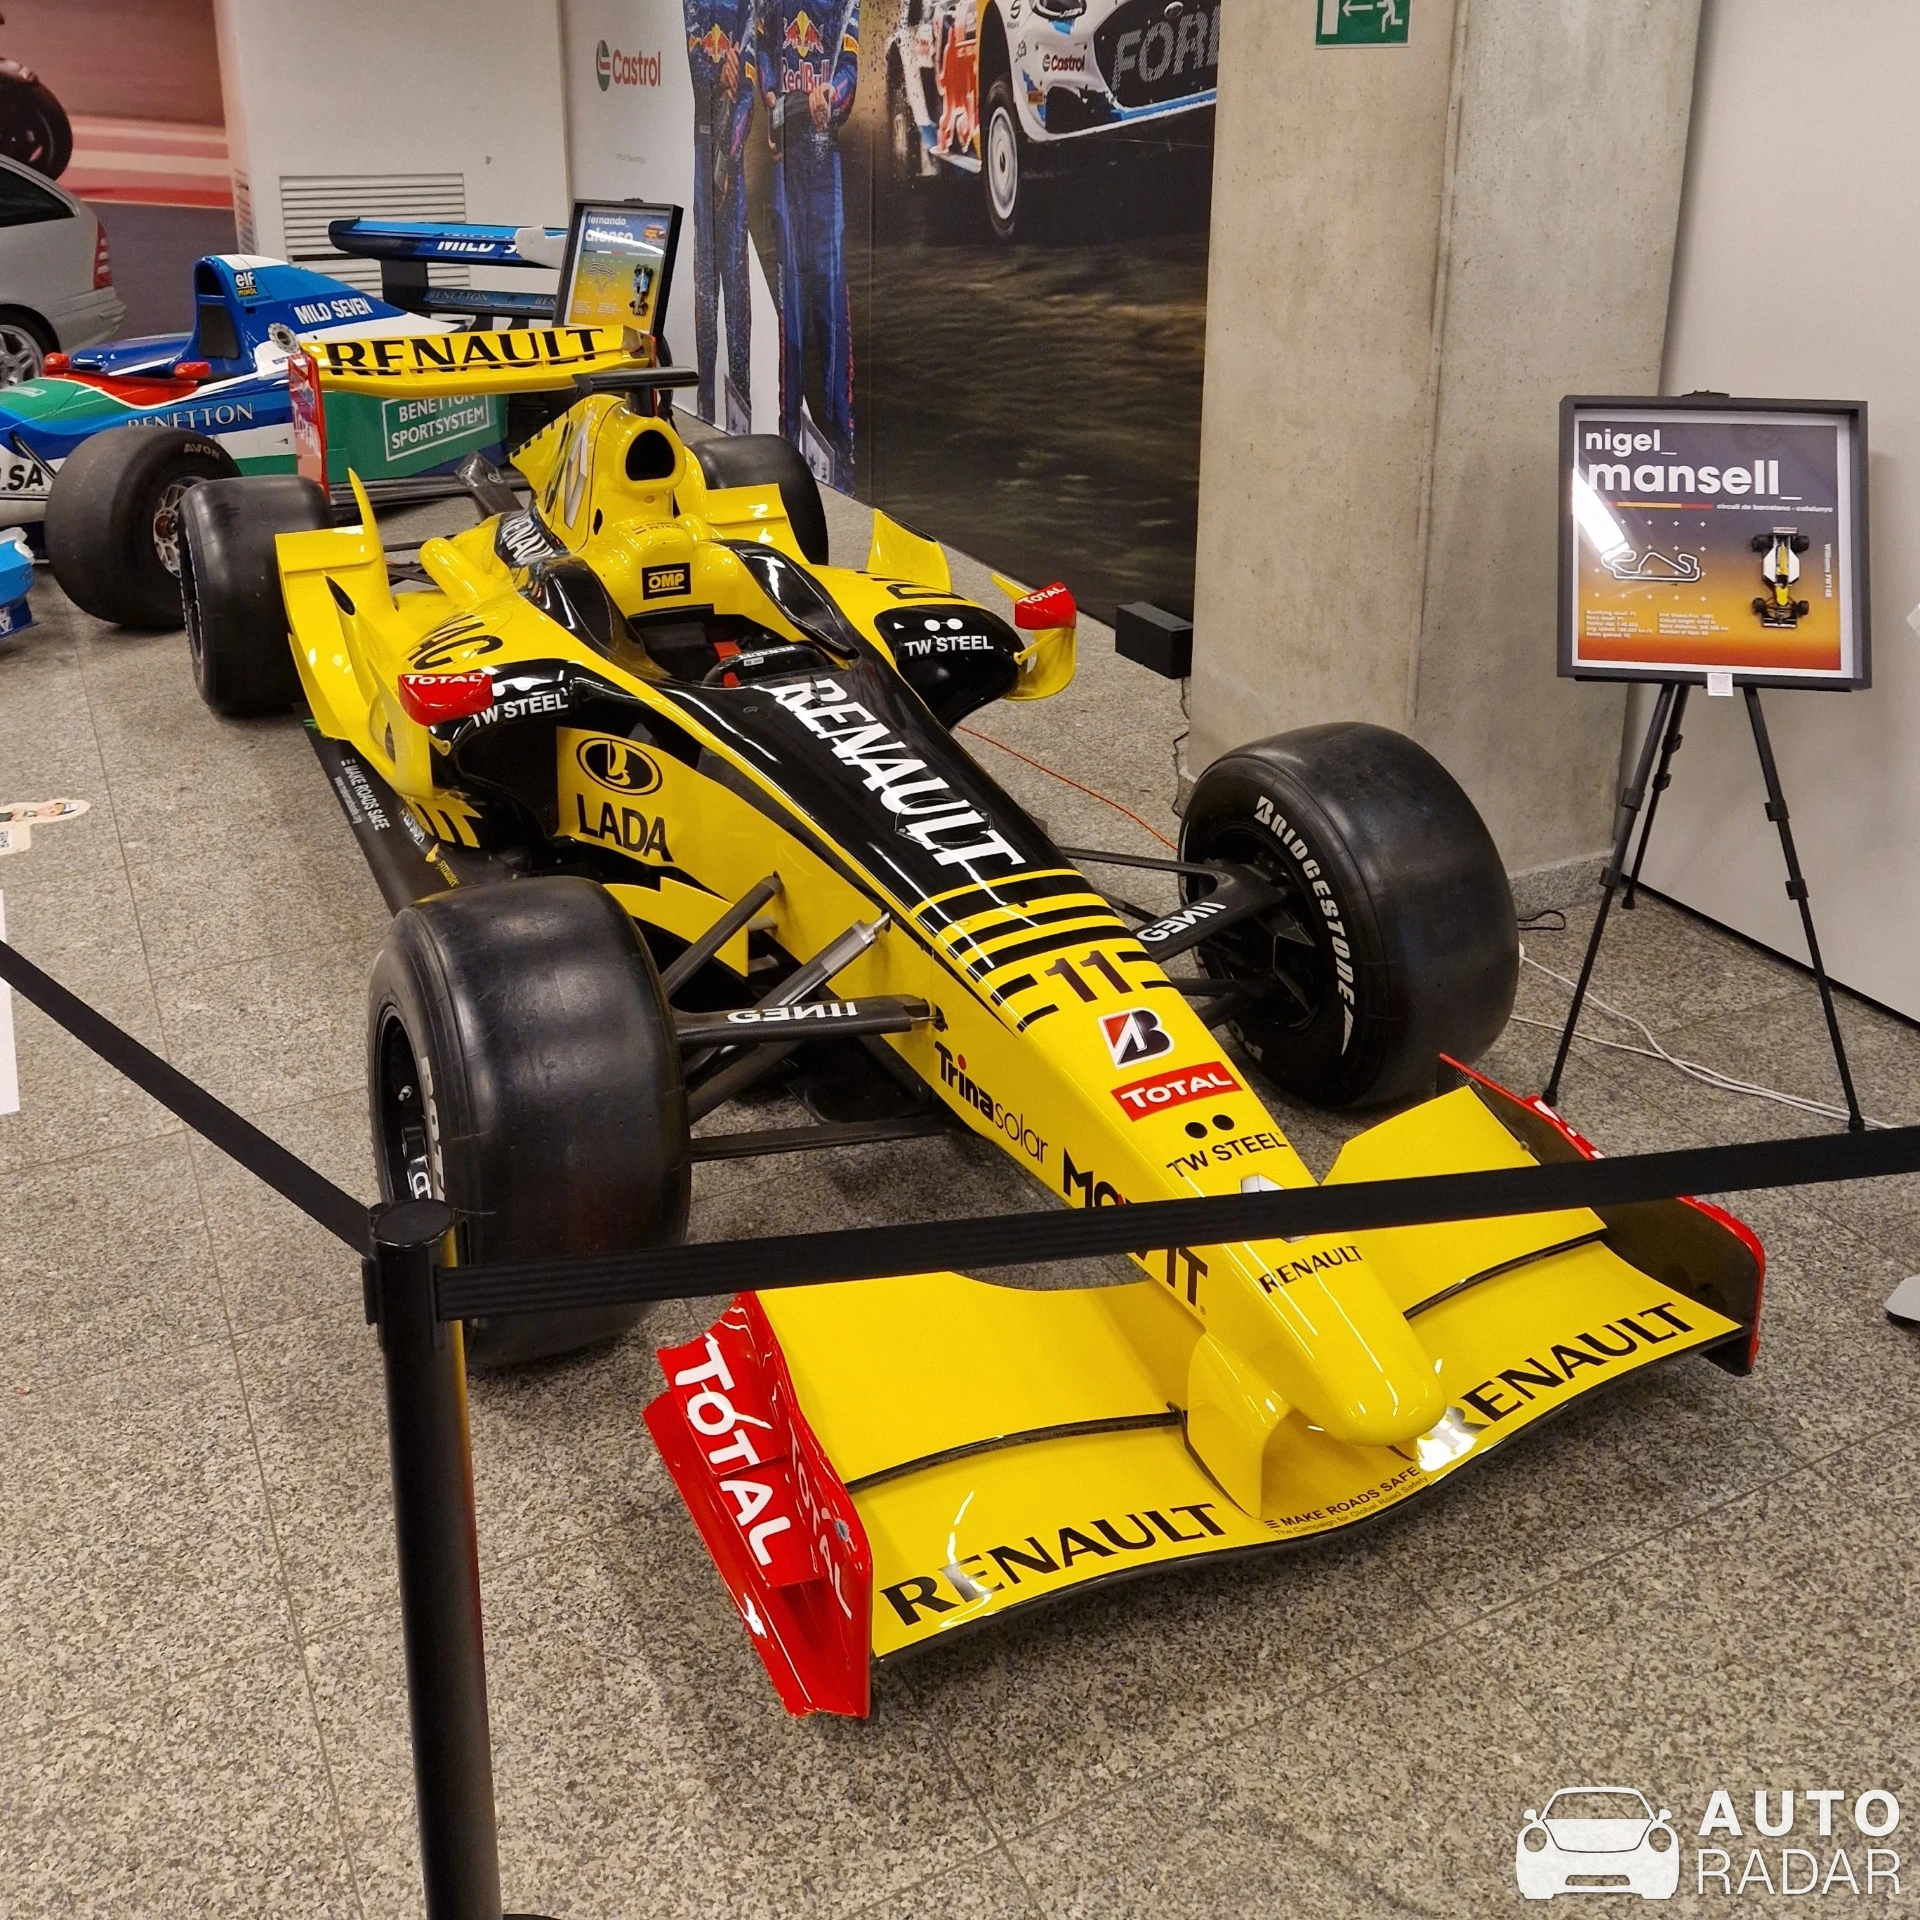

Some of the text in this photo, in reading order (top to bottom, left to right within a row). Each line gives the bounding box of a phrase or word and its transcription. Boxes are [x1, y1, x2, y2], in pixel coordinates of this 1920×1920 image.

[612, 49, 661, 87] Castrol
[1051, 52, 1085, 72] Castrol
[1111, 4, 1219, 93] FOR
[235, 272, 256, 288] elf
[428, 290, 489, 302] BENETTON
[294, 298, 374, 324] MILD SEVEN
[326, 329, 604, 377] RENAULT
[391, 405, 485, 450] SPORTSYSTEM
[184, 442, 220, 460] AVON
[648, 572, 685, 589] OMP
[1017, 587, 1067, 604] TOTAL
[904, 635, 994, 657] TW STEEL
[404, 674, 486, 686] TOTAL
[504, 693, 569, 719] STEEL
[771, 678, 1027, 867] RENAULT
[576, 794, 675, 862] LADA
[1253, 795, 1355, 1006] BRIDGESTONE
[1044, 950, 1133, 1003] 11
[1120, 1071, 1236, 1109] TOTAL
[1166, 1132, 1288, 1178] TW STEEL
[1258, 1245, 1364, 1295] RENAULT
[1428, 1301, 1694, 1456] RENAULT
[675, 1332, 792, 1567] TOTAL
[1280, 1466, 1421, 1527] MAKE ROADS SAFE
[1293, 1517, 1338, 1534] Campaign
[1349, 1502, 1378, 1518] Global
[1377, 1490, 1402, 1506] Road
[1400, 1475, 1429, 1493] Safety
[879, 1503, 1228, 1627] RENAULT
